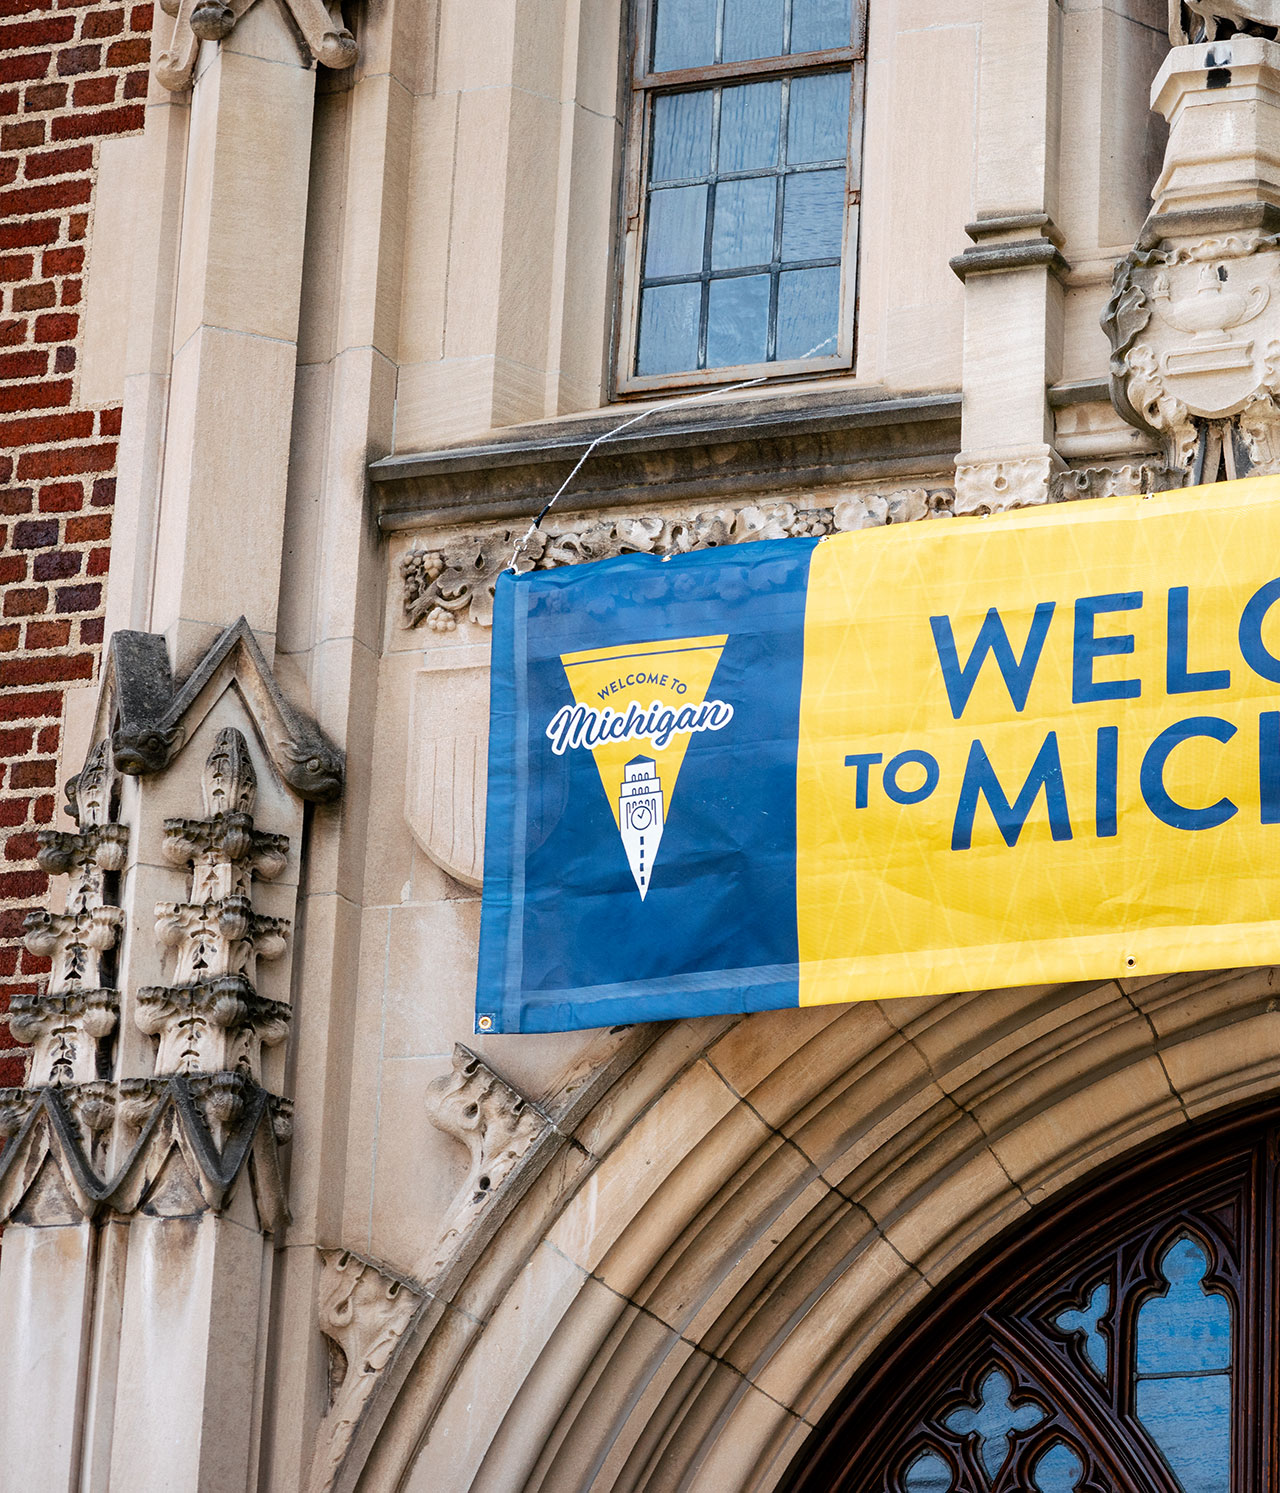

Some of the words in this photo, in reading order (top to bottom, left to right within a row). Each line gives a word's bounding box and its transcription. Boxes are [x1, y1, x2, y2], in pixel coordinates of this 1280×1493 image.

[597, 672, 668, 701] WELCOME
[670, 678, 688, 695] TO
[547, 701, 733, 755] Michigan
[844, 750, 940, 809] TO
